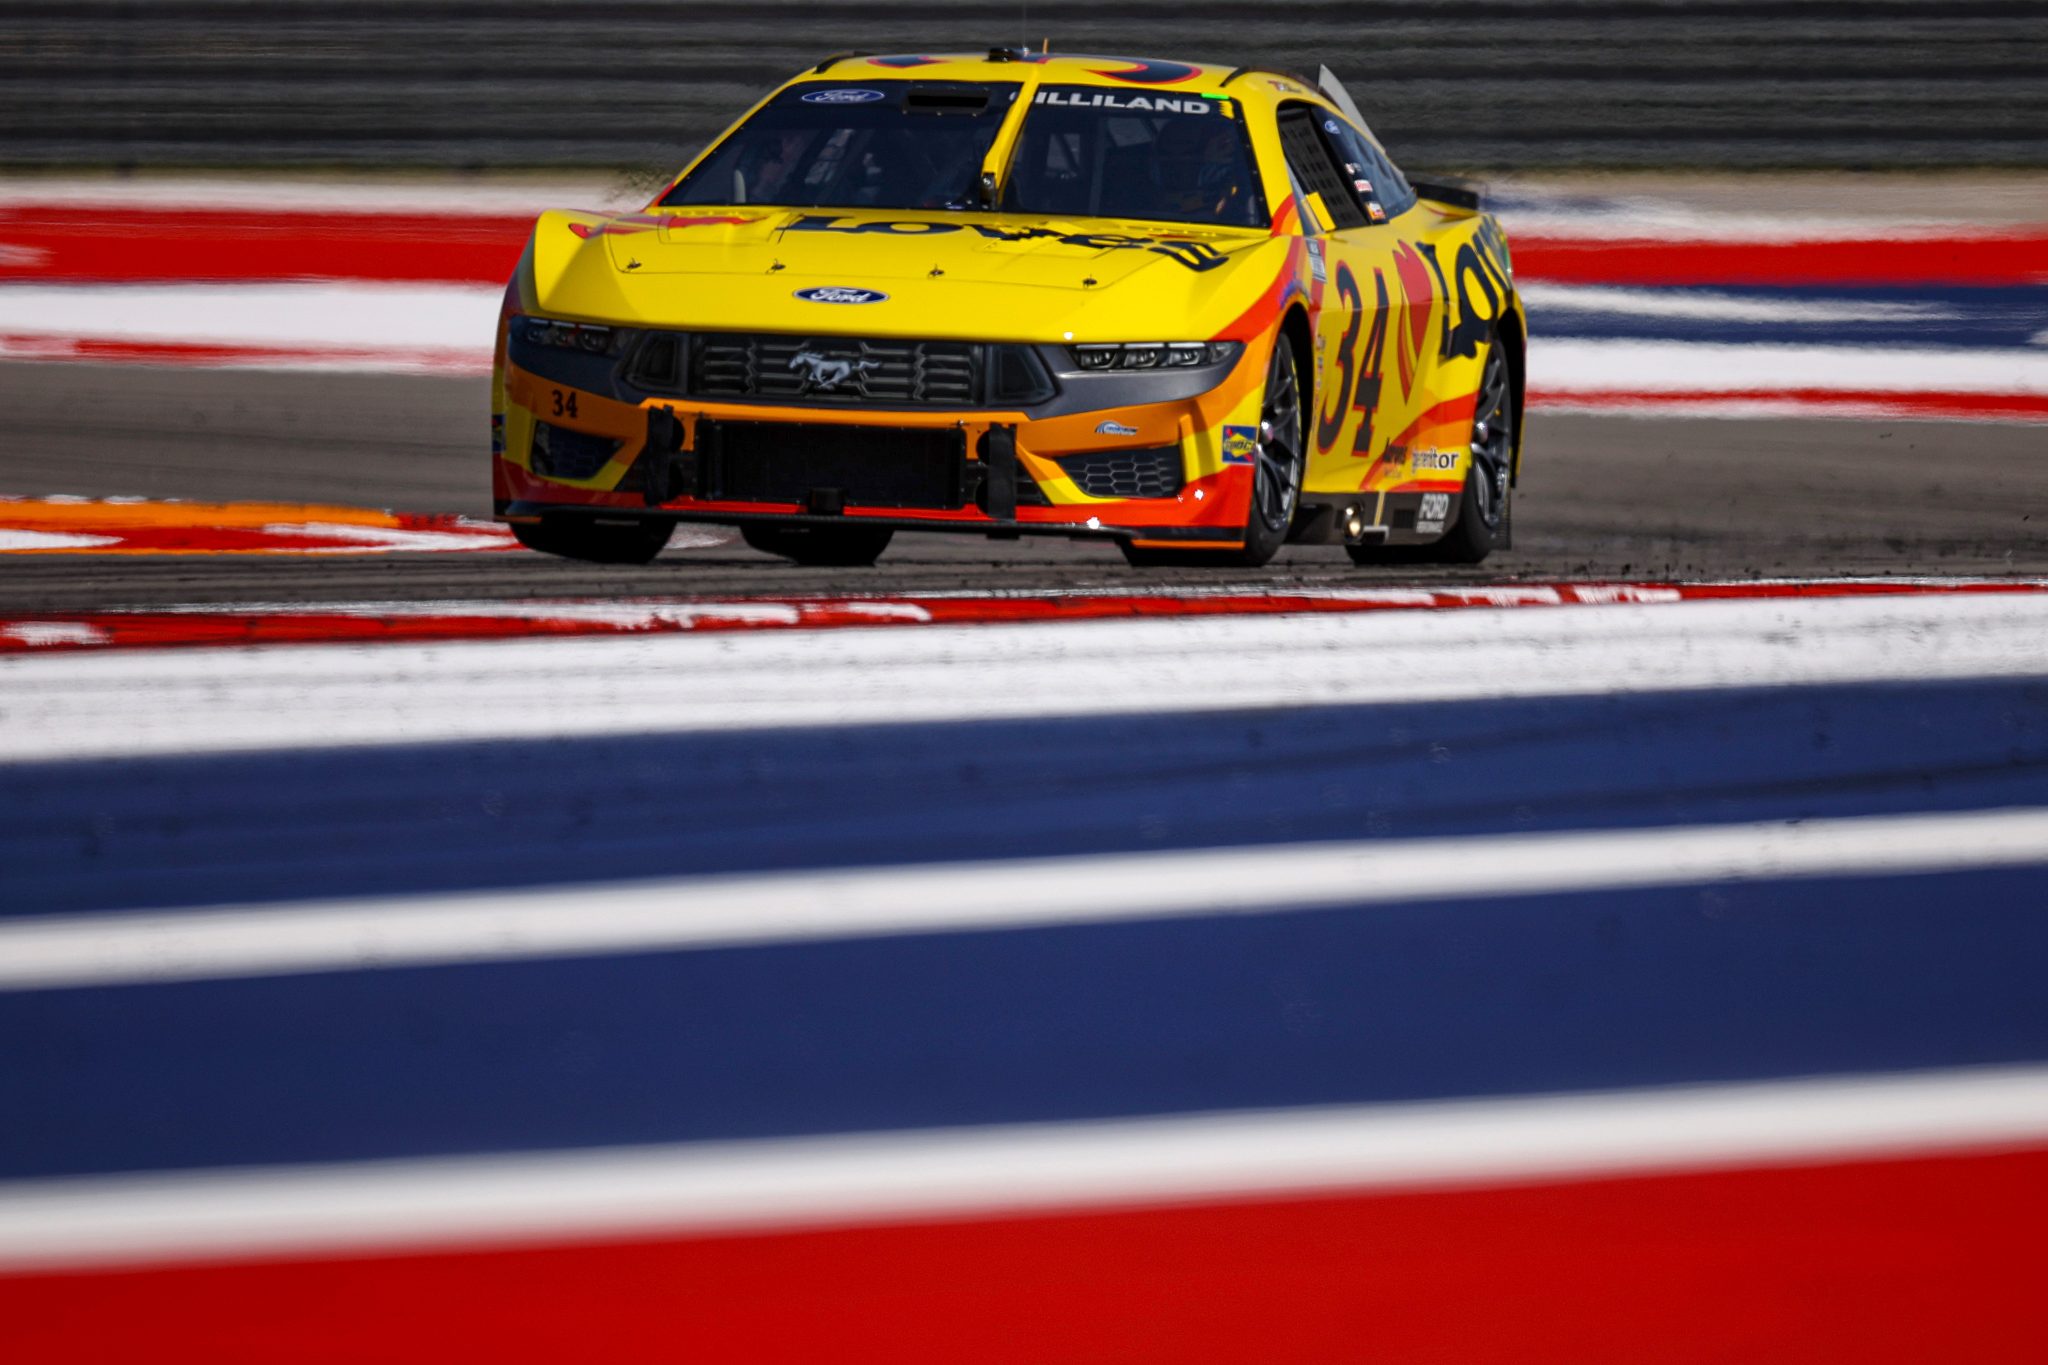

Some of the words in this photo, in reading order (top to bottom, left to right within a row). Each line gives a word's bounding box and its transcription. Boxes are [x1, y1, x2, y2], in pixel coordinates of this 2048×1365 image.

[814, 90, 872, 102] Ford
[810, 288, 872, 302] Ford
[1317, 259, 1390, 457] 34
[552, 389, 578, 418] 34
